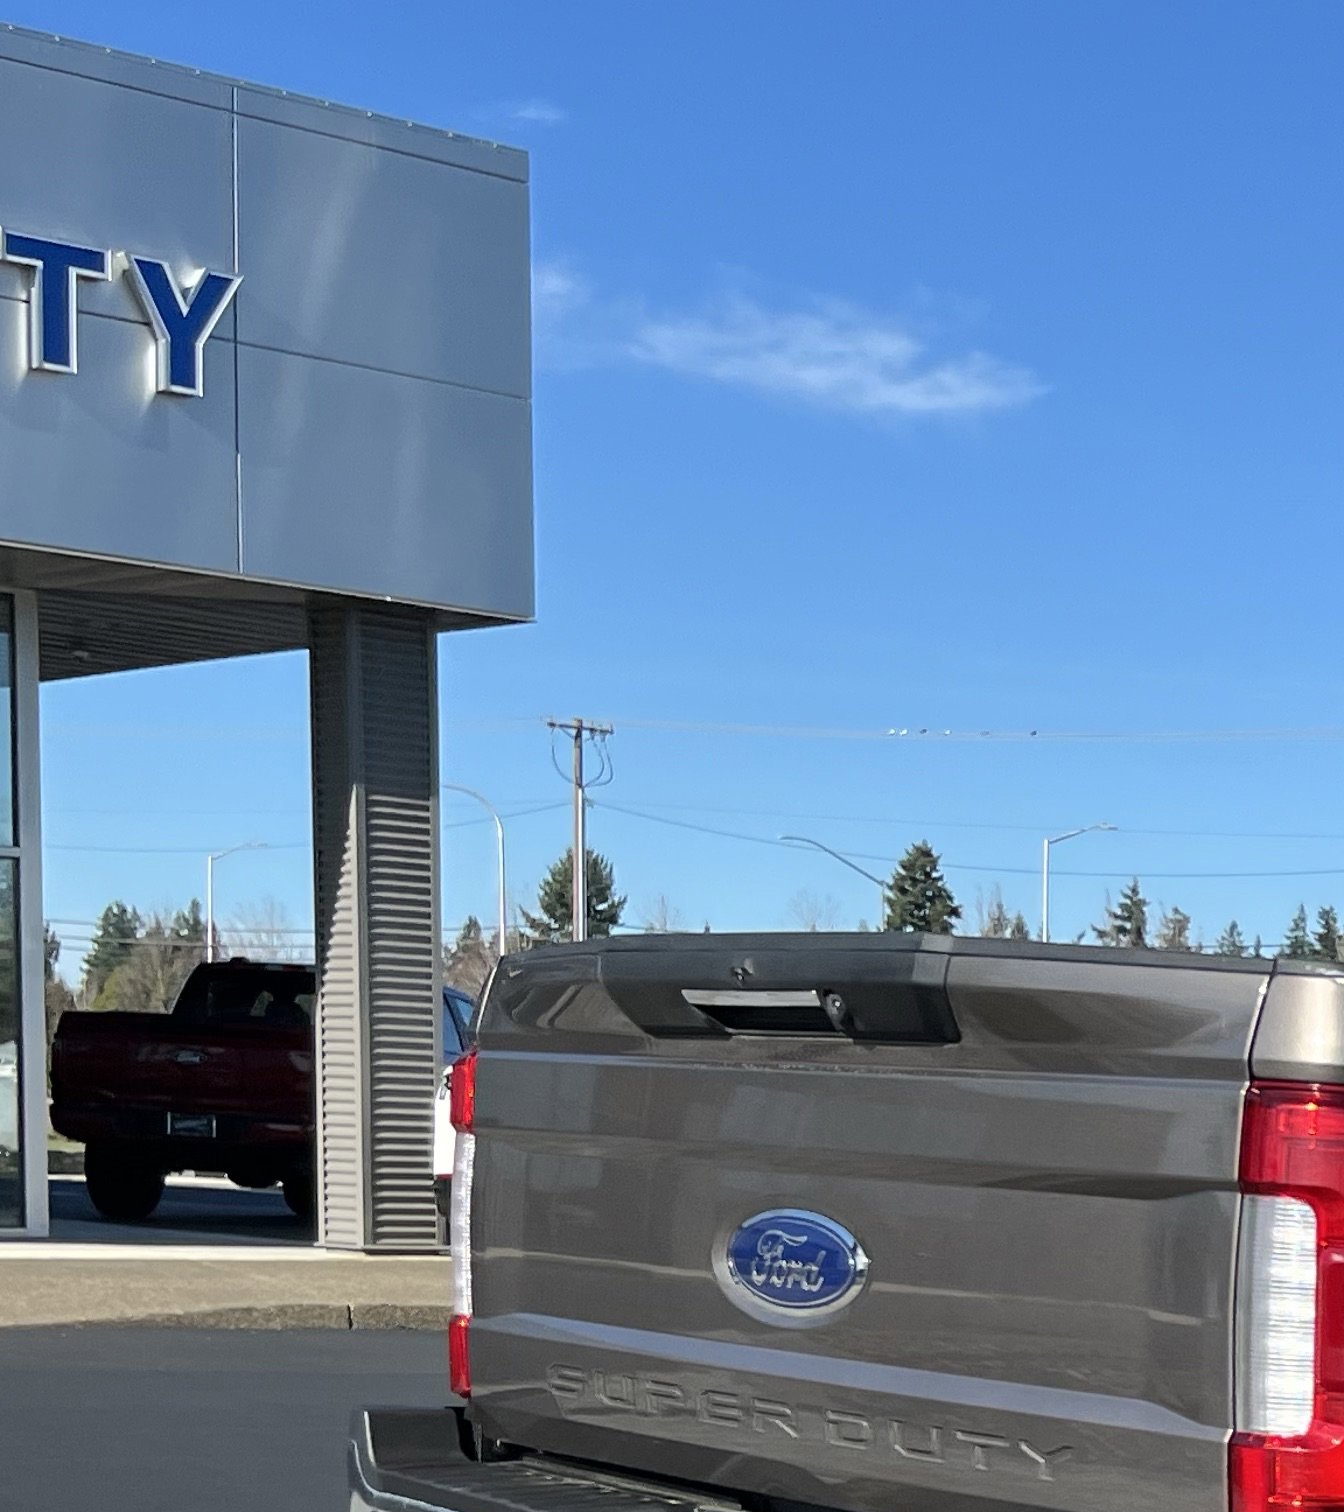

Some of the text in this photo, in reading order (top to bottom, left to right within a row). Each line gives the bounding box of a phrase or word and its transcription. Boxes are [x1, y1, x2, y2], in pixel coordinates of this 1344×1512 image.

[1, 228, 244, 398] TY
[751, 1229, 827, 1292] Ford
[547, 1362, 1076, 1482] SUPER DUTY
